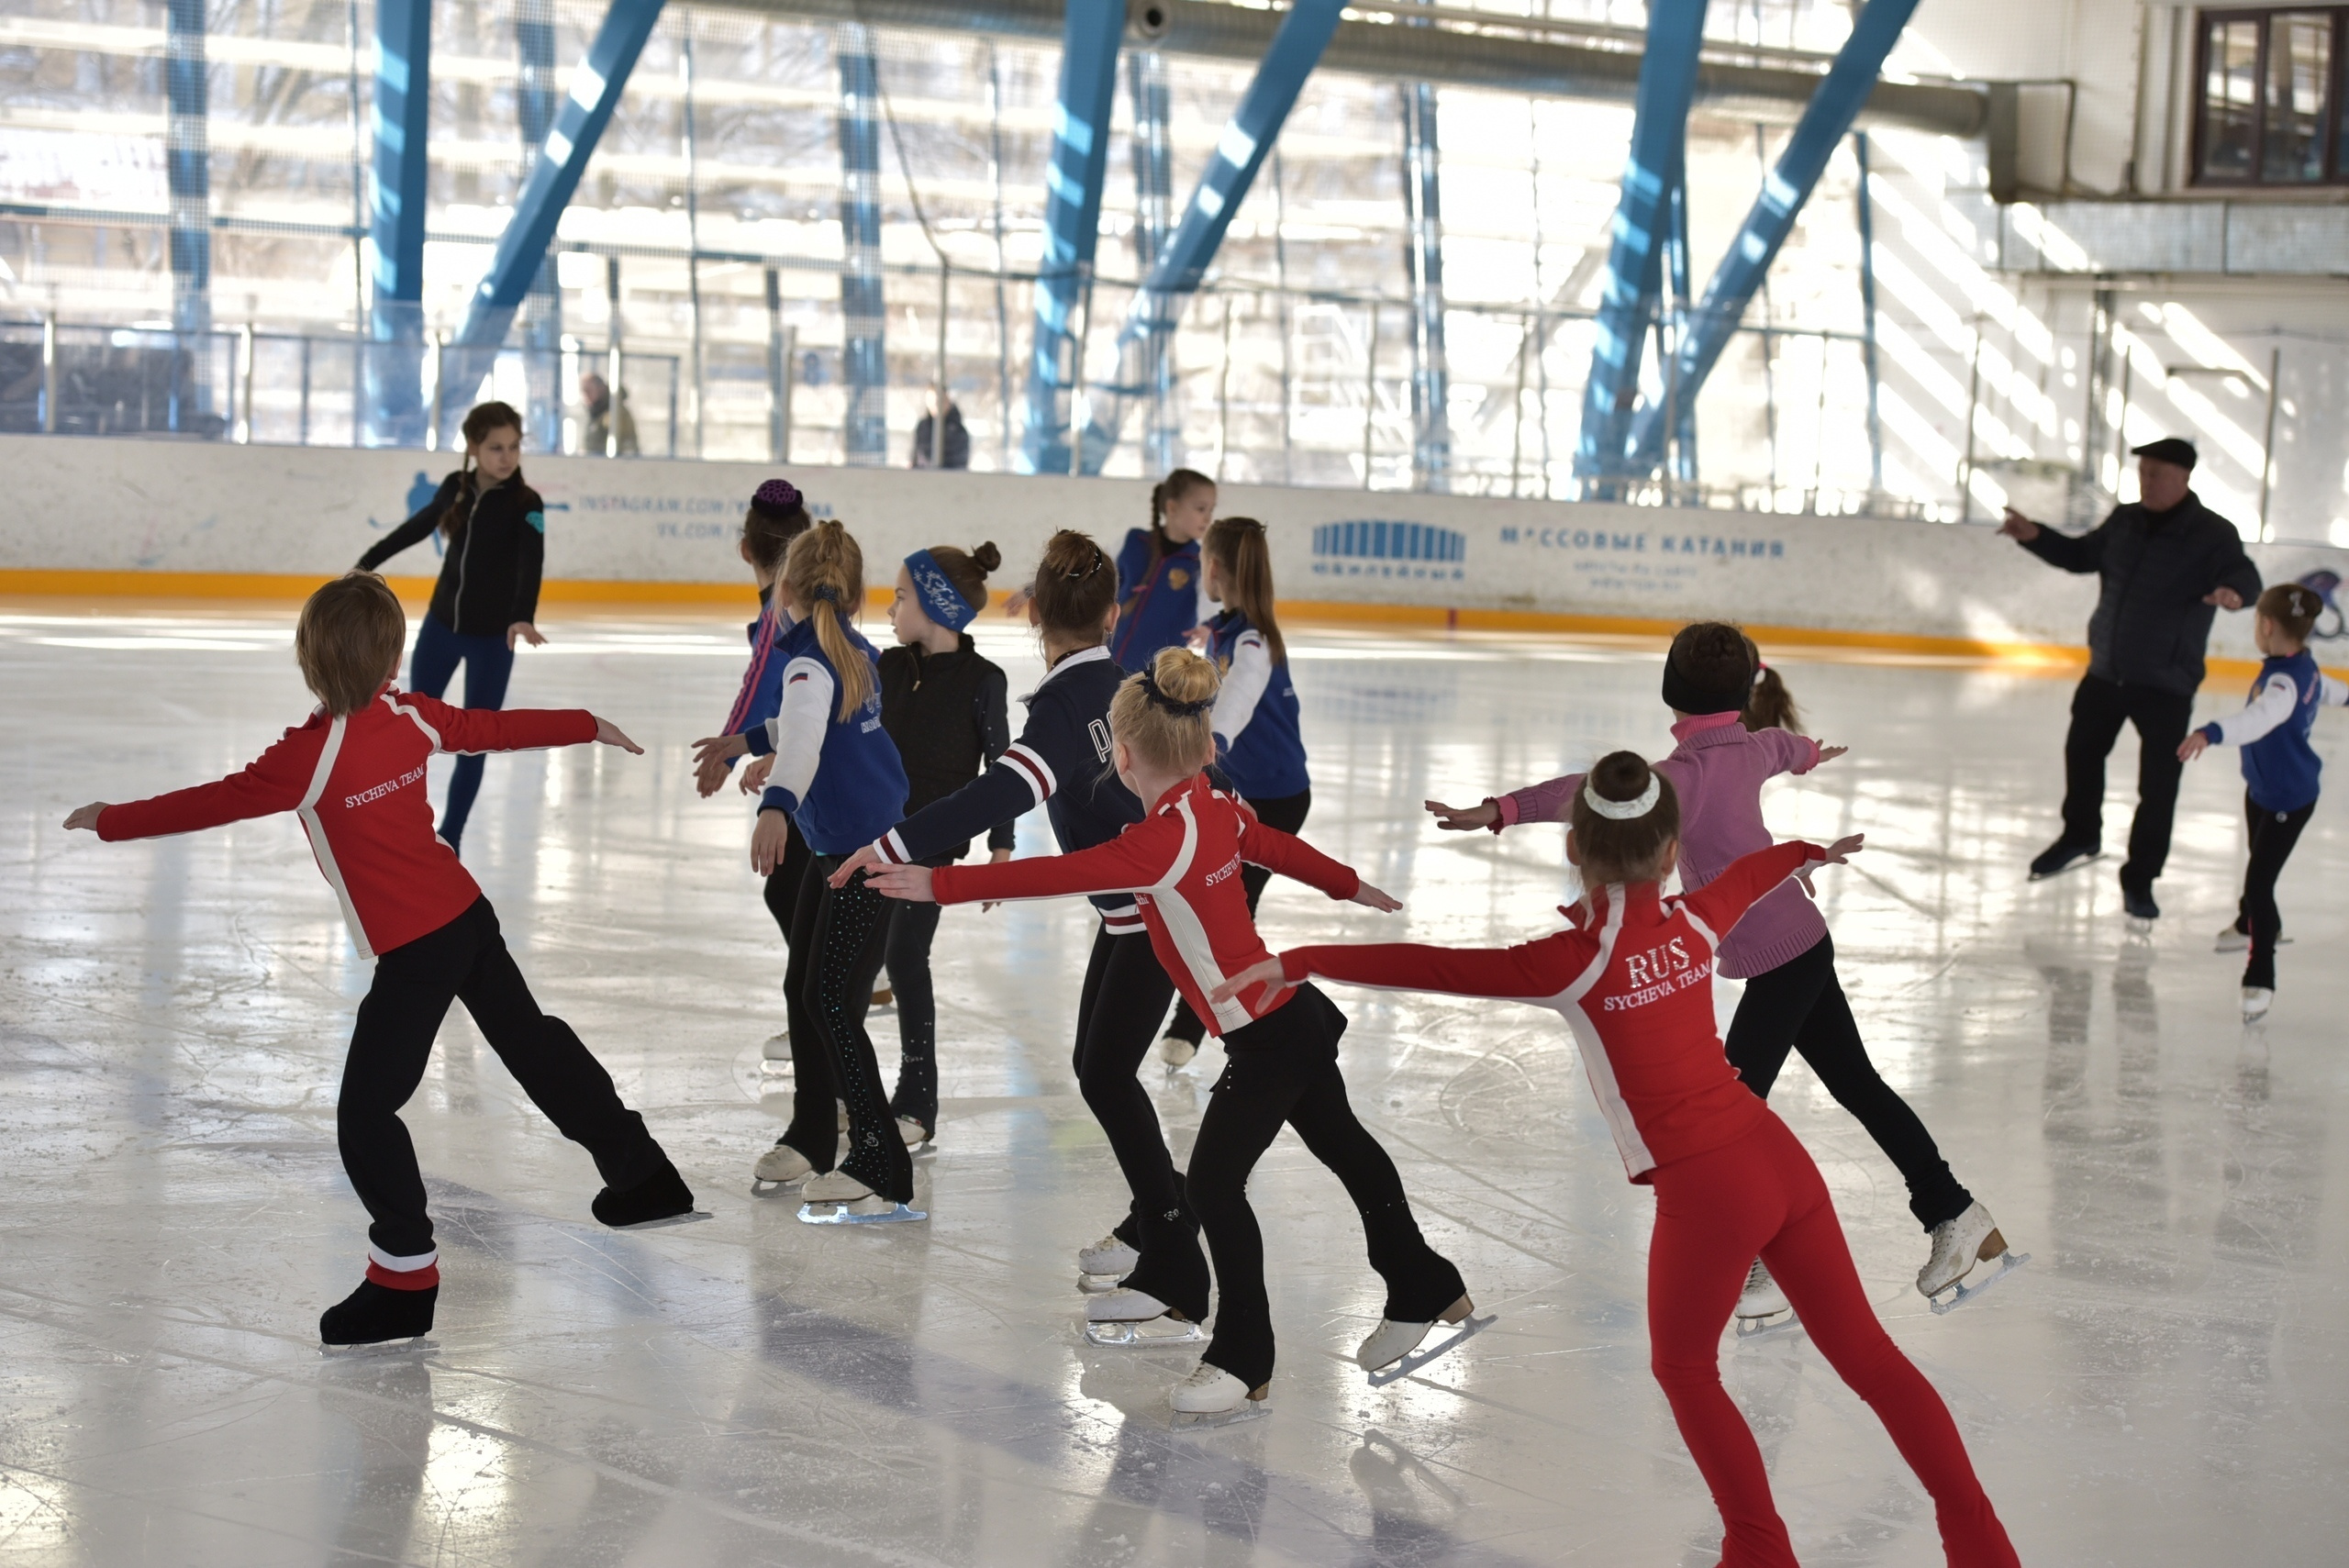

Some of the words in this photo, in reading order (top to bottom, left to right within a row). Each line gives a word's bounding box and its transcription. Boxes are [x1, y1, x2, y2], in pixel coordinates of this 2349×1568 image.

[1500, 526, 1646, 553] МССОВЫЕ
[1661, 535, 1786, 560] КАТАНИЯ
[345, 779, 399, 808] SYCHEVA
[399, 763, 425, 787] TEAM
[1604, 980, 1675, 1011] SYCHEVA
[1676, 959, 1711, 988] TEAM
[1625, 936, 1690, 989] RUS
